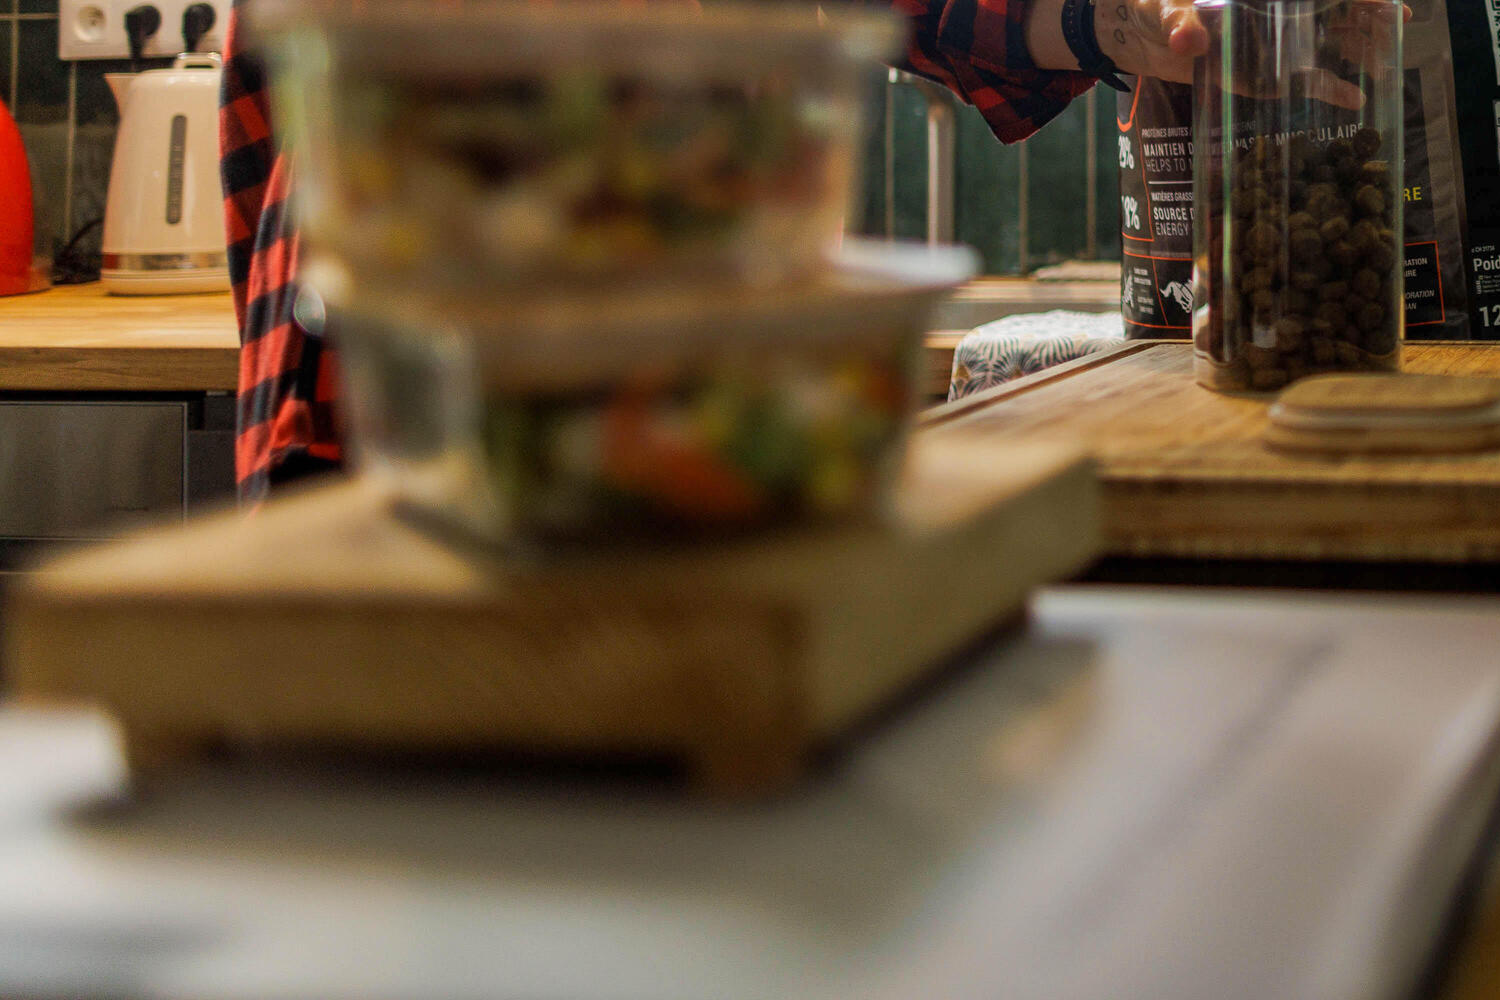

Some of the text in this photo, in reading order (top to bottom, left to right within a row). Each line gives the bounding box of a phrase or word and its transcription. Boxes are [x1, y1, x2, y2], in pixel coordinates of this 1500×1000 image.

[1143, 143, 1186, 157] MAINTIEN
[1145, 158, 1186, 173] HELPS TO
[1153, 206, 1188, 221] SOURCE
[1155, 221, 1189, 236] ENERGY
